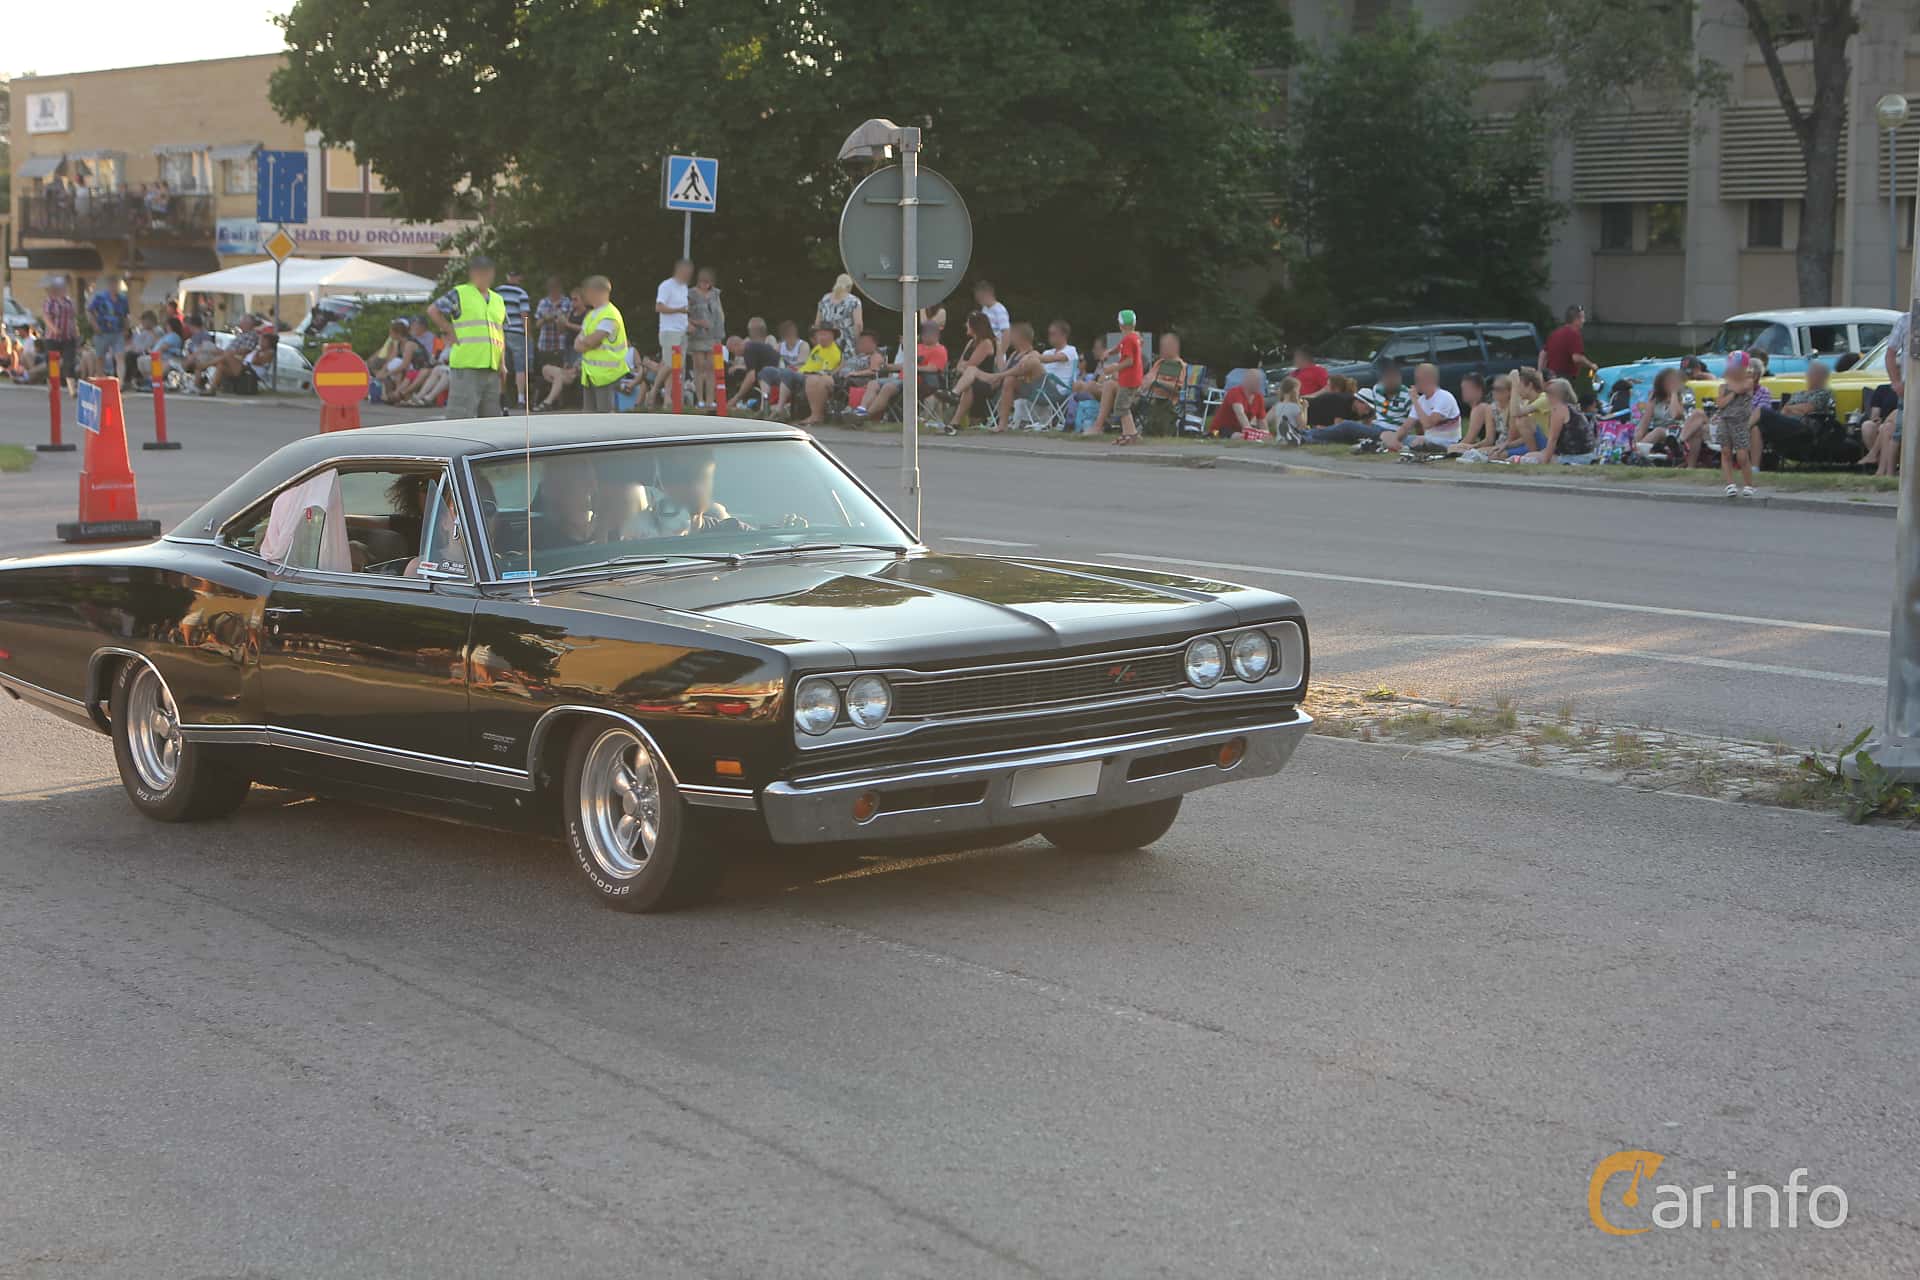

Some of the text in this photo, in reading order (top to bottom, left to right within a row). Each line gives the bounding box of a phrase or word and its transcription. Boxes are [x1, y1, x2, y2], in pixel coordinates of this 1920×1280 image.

[295, 229, 330, 242] HAR
[336, 229, 360, 242] DU
[570, 822, 630, 895] BFGoodrich
